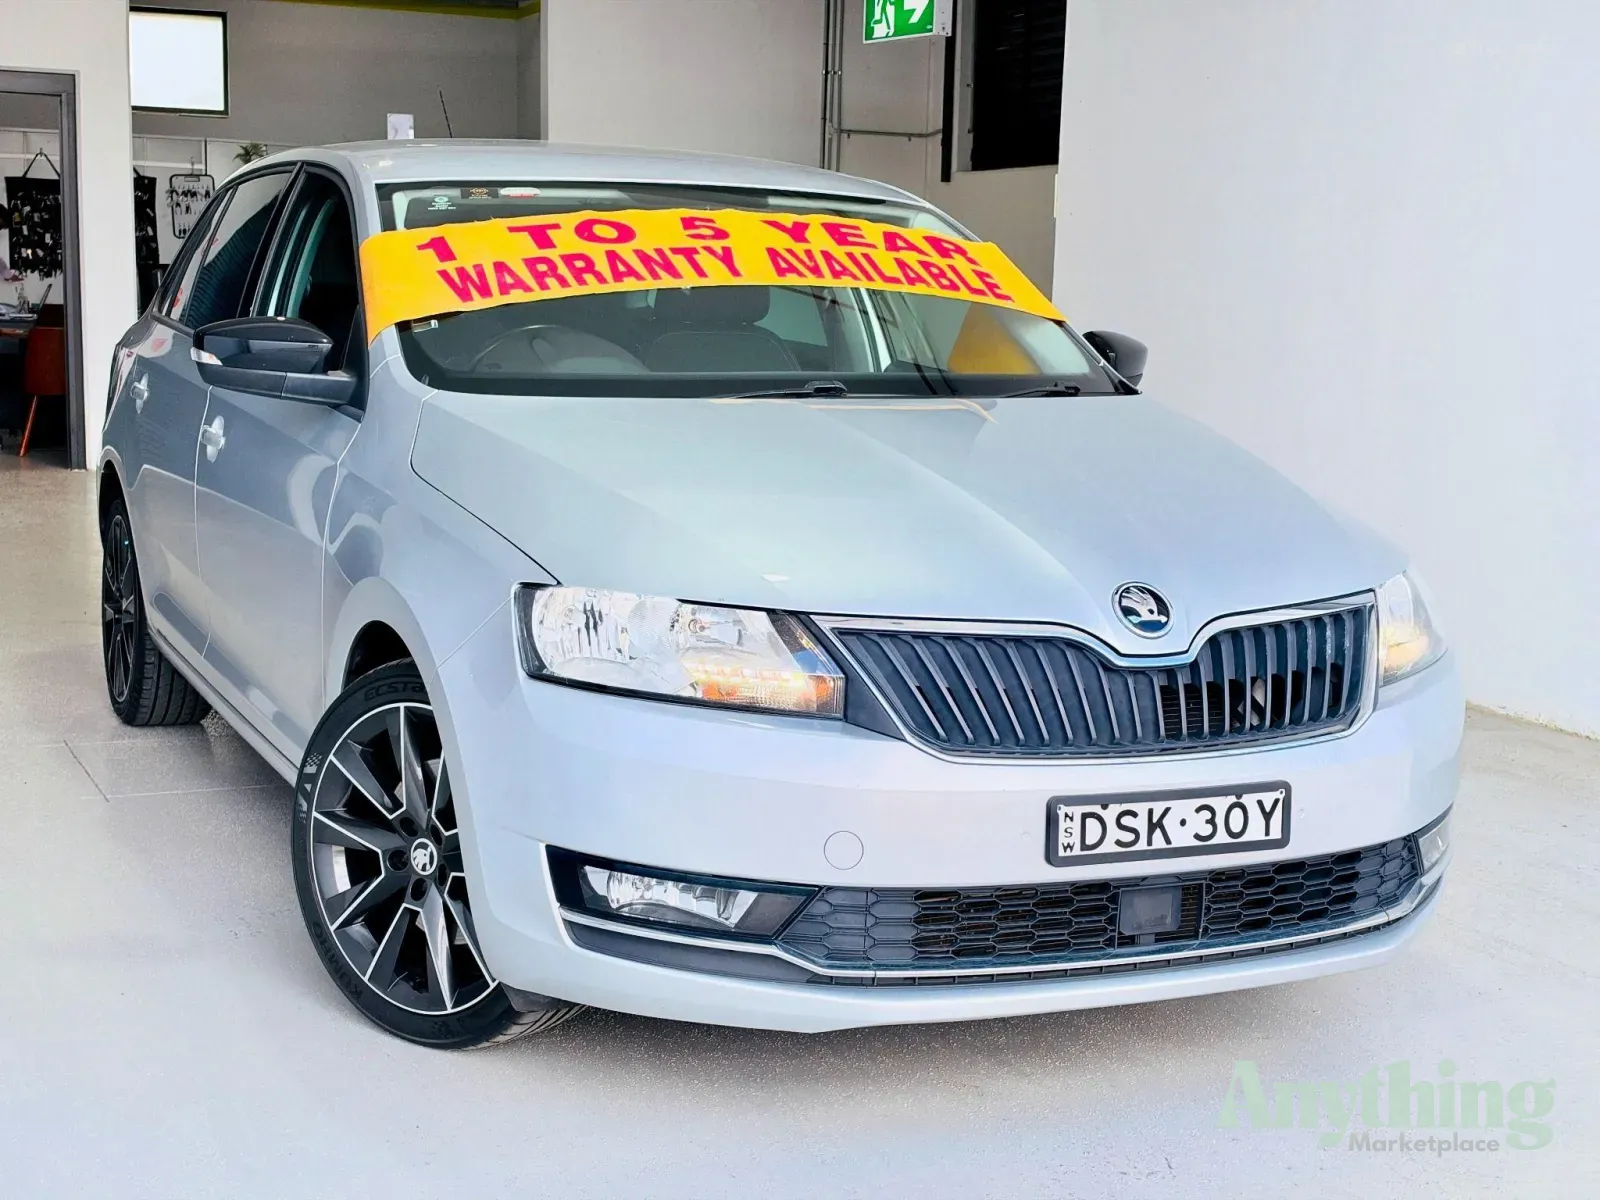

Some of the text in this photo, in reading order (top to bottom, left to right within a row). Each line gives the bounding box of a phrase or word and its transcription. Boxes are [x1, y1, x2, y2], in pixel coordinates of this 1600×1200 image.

[416, 216, 983, 268] 1 TO 5 YEAR
[436, 245, 1014, 304] WARRANTY AVAILABLE
[312, 921, 363, 1001] KUMHO
